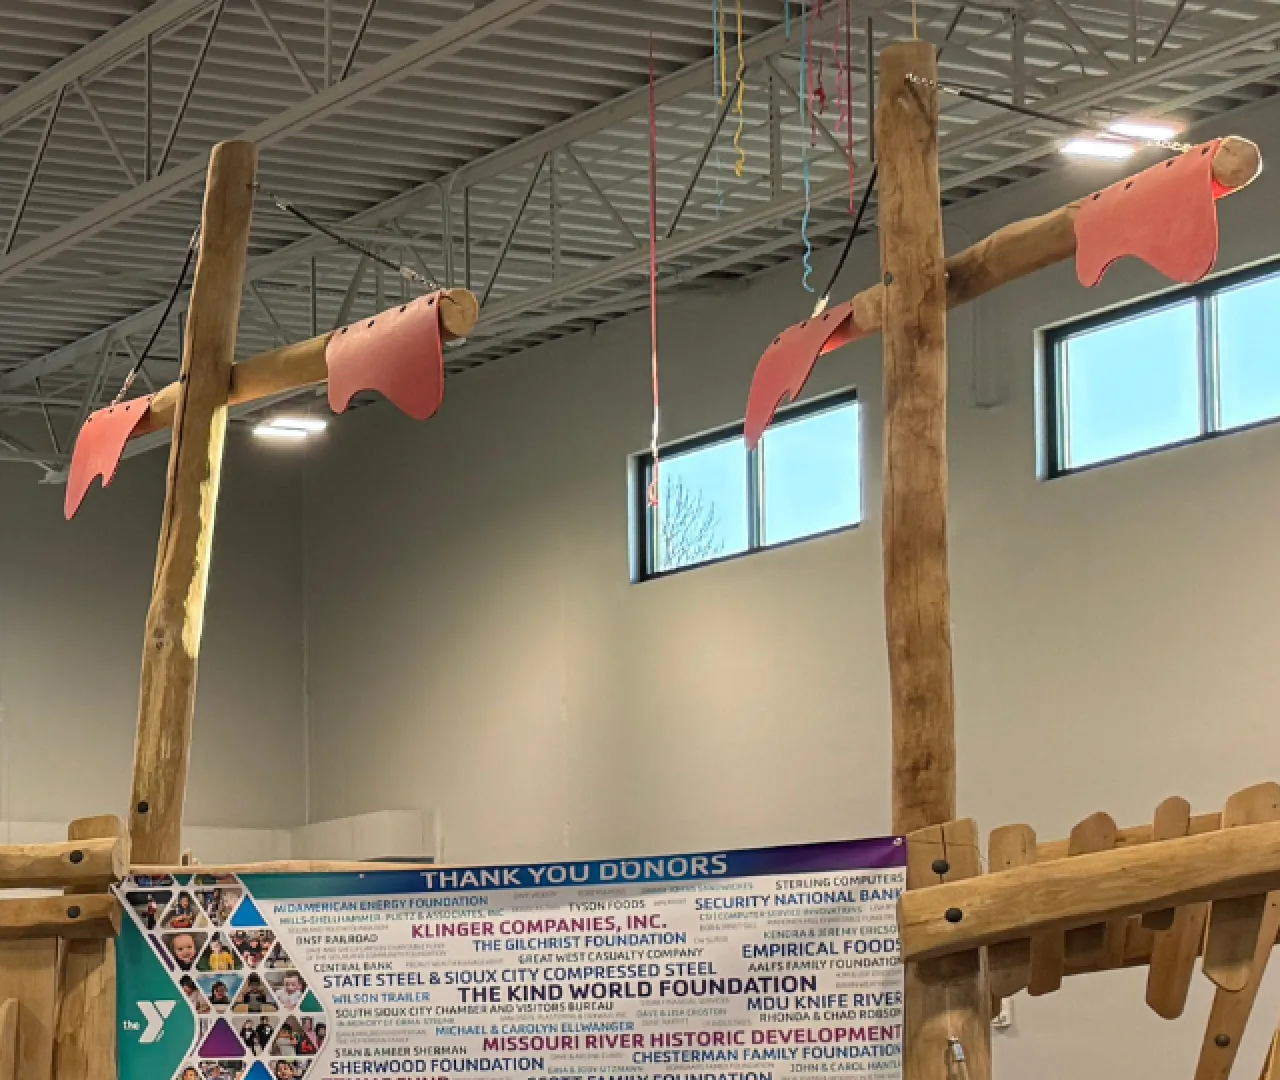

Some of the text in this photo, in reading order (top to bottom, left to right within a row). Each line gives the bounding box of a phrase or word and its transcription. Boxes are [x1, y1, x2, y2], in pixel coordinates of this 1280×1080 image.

[420, 854, 728, 889] THANK YOU DONORS
[775, 872, 904, 891] STERLING COMPUTERS
[273, 895, 488, 914] MIDAMERICAN ENERGY FOUNDATION
[568, 901, 605, 912] TYSON
[607, 899, 646, 910] FOODS
[694, 894, 770, 911] SECURITY
[773, 889, 856, 907] NATIONAL
[859, 887, 903, 902] BANK
[411, 913, 667, 939] KLINGER COMPANIES, INC.
[763, 930, 806, 940] KENDRA
[859, 924, 898, 935] ERICSO
[325, 933, 379, 945] RAILROAD
[472, 939, 501, 952] THE
[505, 936, 581, 951] GILCHRIST
[584, 931, 687, 949] FOUNDATION
[741, 937, 901, 959] EMPIRICAL FOODS
[517, 951, 553, 964] GREAT
[555, 951, 585, 963] WEST
[587, 949, 645, 962] CASUALTY
[646, 947, 704, 959] COMPANY
[313, 961, 393, 973] CENTRAL BANK
[785, 959, 827, 971] FAMILY
[323, 961, 717, 989] STATE STEEL & SIOUX CITY COMPRESSED STEEL
[332, 991, 430, 1004] WILSON TRAILER
[457, 986, 501, 1003] THE
[507, 984, 563, 1001] KIND
[568, 980, 653, 1000] WORLD
[659, 975, 817, 998] FOUNDATION
[747, 996, 789, 1011] MDU
[794, 993, 849, 1009] KNIFE
[853, 990, 902, 1007] RIVER
[335, 1001, 613, 1019] SOUTH SIOUX CITY CHAMBER AND VISITORS BUREAU
[759, 1011, 811, 1022] RHONDA
[823, 1010, 857, 1021] CHAD
[435, 1024, 488, 1036] MICHAEL
[490, 1024, 499, 1035] &
[501, 1023, 558, 1035] CAROLYN
[561, 1021, 635, 1033] ELLWANGER
[481, 1023, 902, 1052] MISSOURI RIVER HISTORIC DEVELOPMENT
[372, 1047, 411, 1057] AMBER
[413, 1045, 467, 1056] SHERMAN
[632, 1049, 739, 1064] CHESTERMAN
[743, 1047, 798, 1061] FAMILY
[329, 1058, 426, 1074] SHERWOOD
[431, 1056, 544, 1072] FOUNDATION
[789, 1063, 818, 1073] JOHN
[830, 1061, 865, 1072] CAROL
